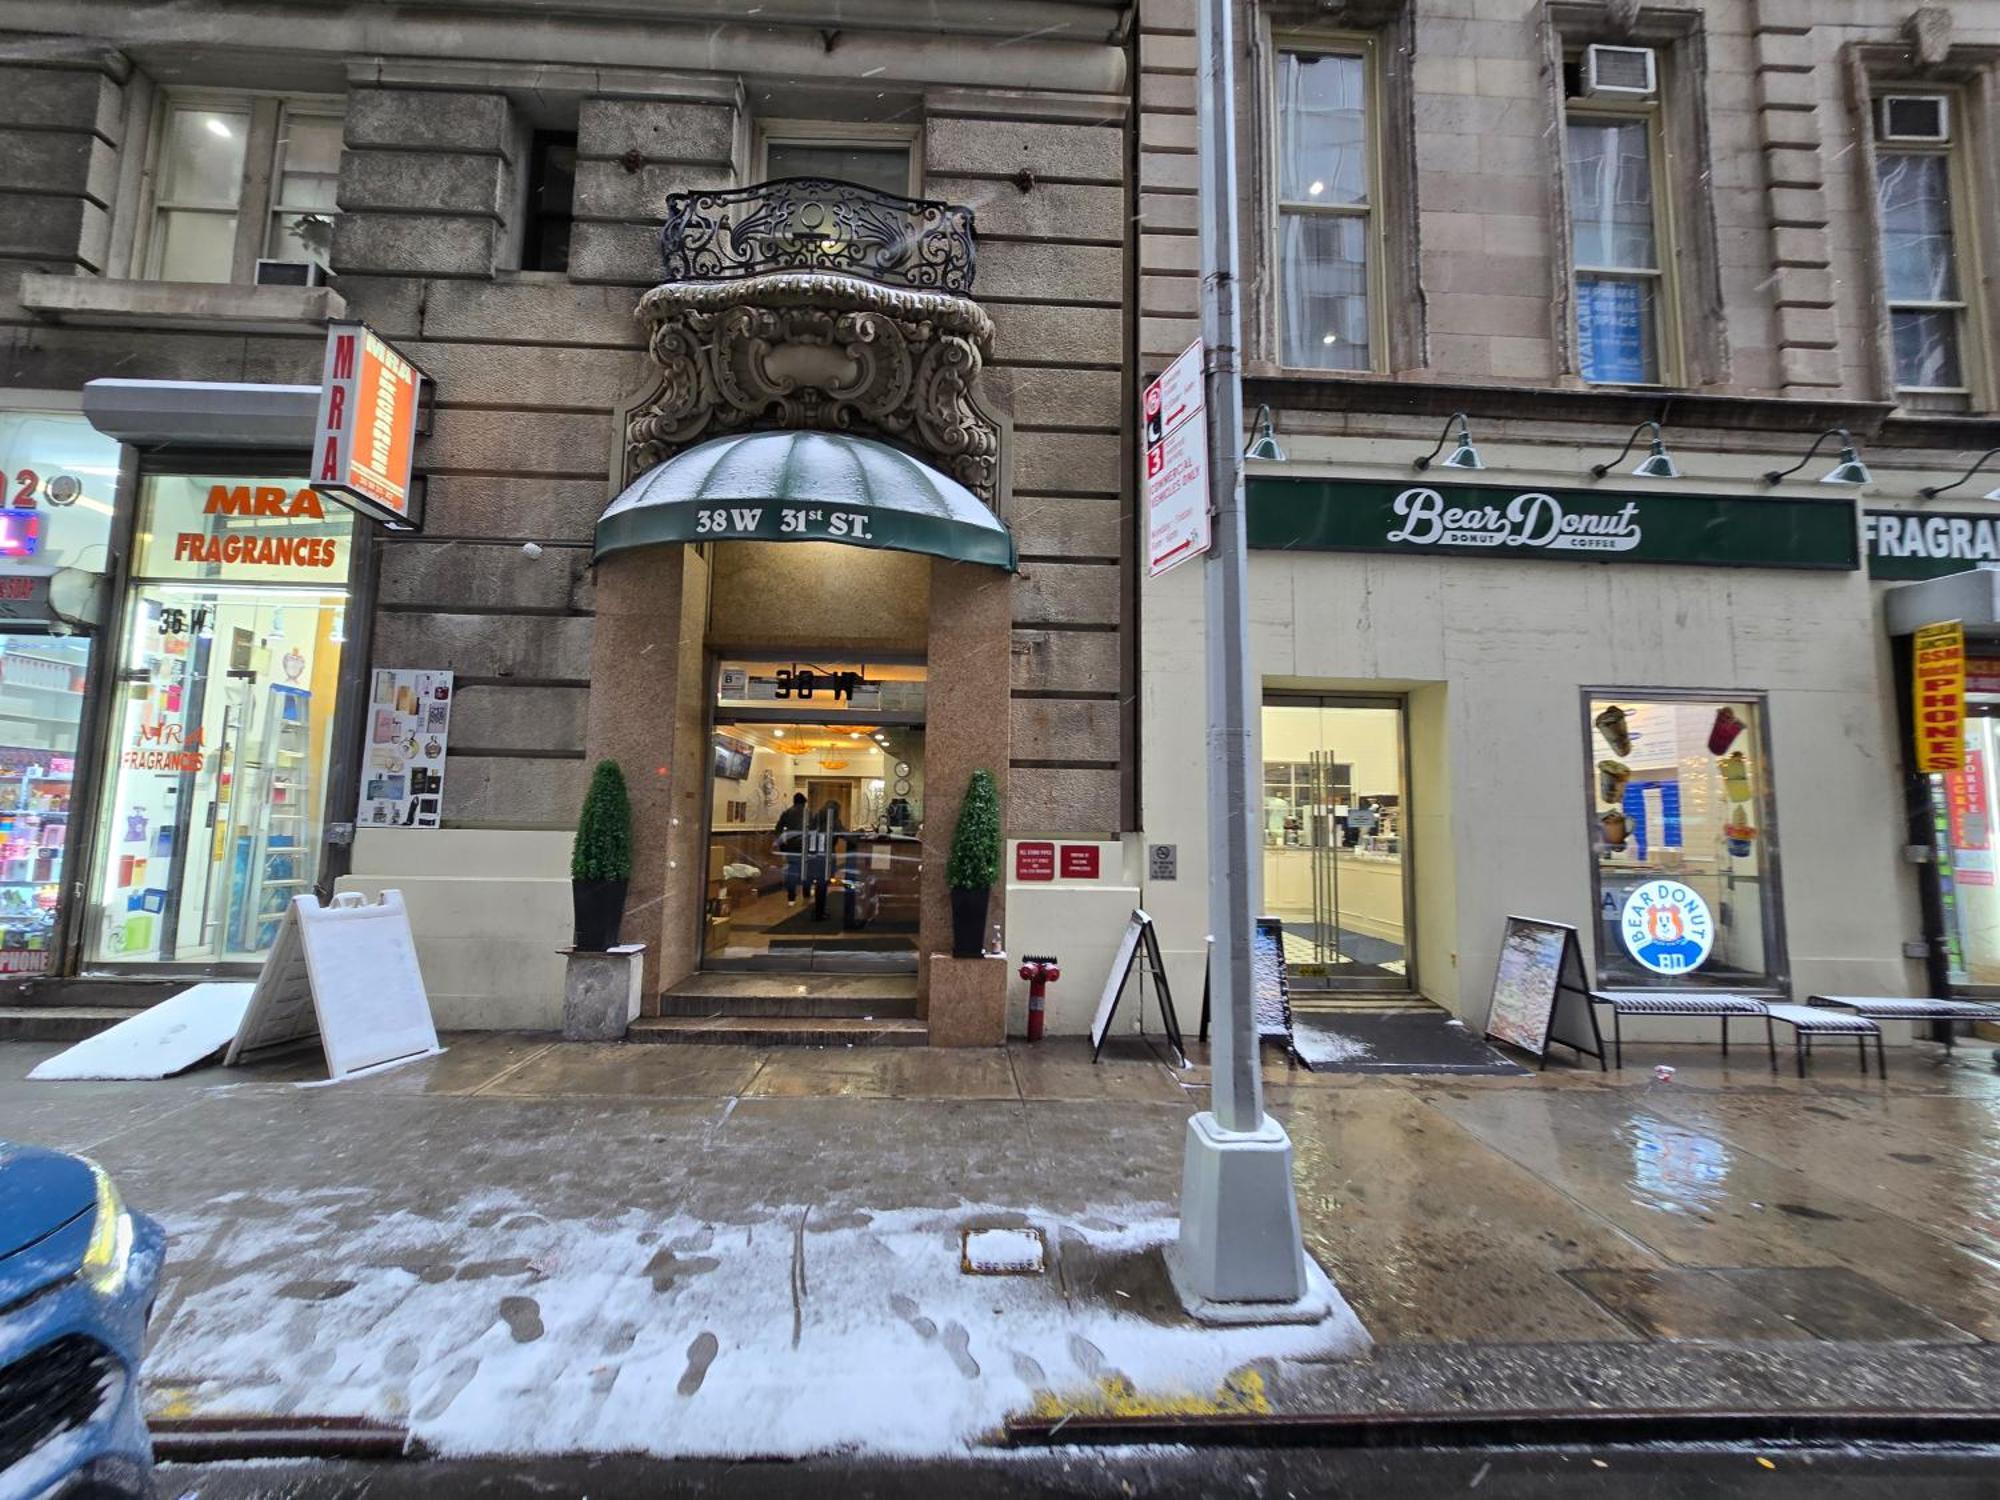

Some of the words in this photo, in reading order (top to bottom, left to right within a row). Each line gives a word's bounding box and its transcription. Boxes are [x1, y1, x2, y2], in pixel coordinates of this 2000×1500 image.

[366, 332, 413, 385] MRA
[321, 335, 355, 481] MRA
[203, 485, 325, 519] MRA
[1387, 487, 1512, 546] Bear
[1505, 493, 1642, 551] Donut
[696, 509, 728, 533] 38
[730, 508, 763, 532] W
[827, 512, 873, 540] ST.
[1450, 533, 1495, 544] DONUT
[1862, 515, 2000, 561] FRAGRA
[174, 532, 337, 568] FRAGRANCES
[1570, 538, 1617, 549] COFFEE
[158, 608, 184, 634] 36
[135, 721, 206, 747] MRA
[1922, 679, 1959, 770] PHONES
[123, 750, 205, 773] FRAGRANCES
[1964, 753, 1981, 814] FOREVE
[1602, 891, 1618, 911] A
[1628, 891, 1654, 943] BEAR
[1658, 884, 1706, 939] DONUT
